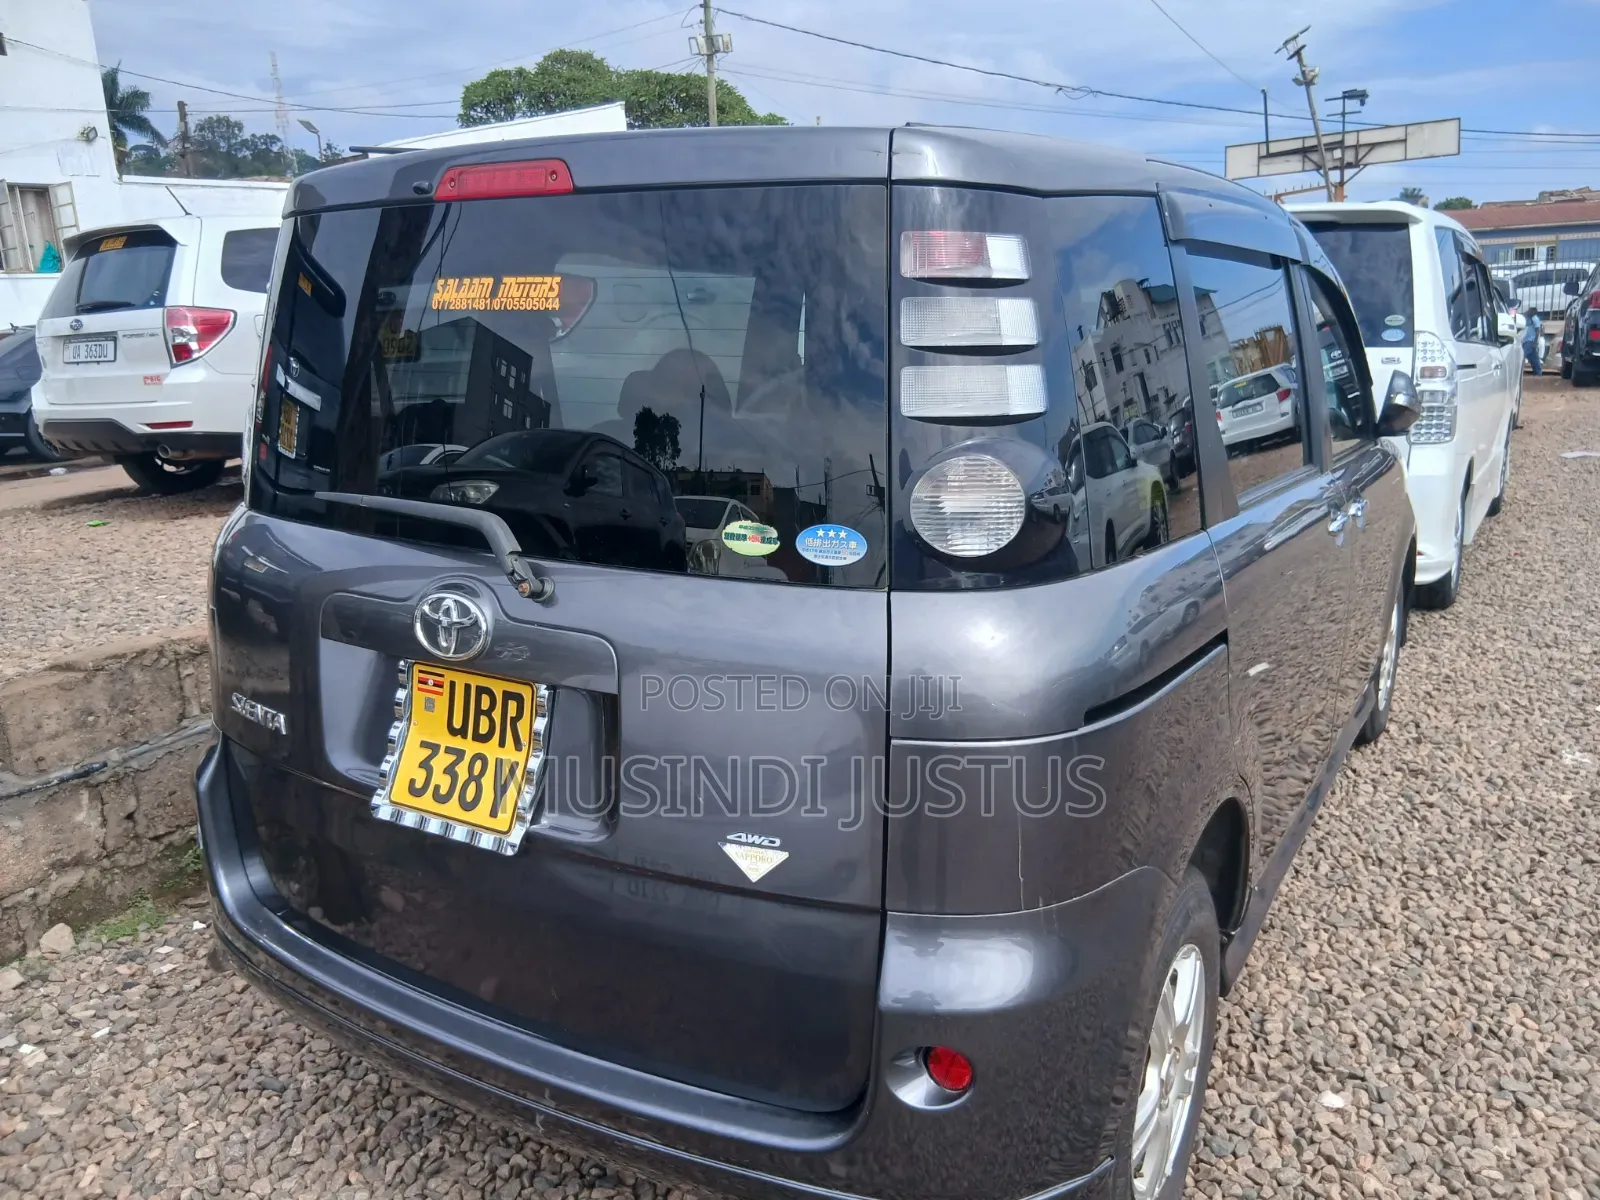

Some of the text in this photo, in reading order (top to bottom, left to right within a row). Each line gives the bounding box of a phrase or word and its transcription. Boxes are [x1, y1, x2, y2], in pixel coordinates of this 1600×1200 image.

[432, 276, 561, 301] SALAAM MOTORS
[431, 297, 560, 310] 0772881481/0705505044
[446, 679, 525, 752] UBR
[407, 740, 519, 819] 338Y
[726, 832, 782, 847] 4WD
[735, 851, 773, 864] SAPPORO
